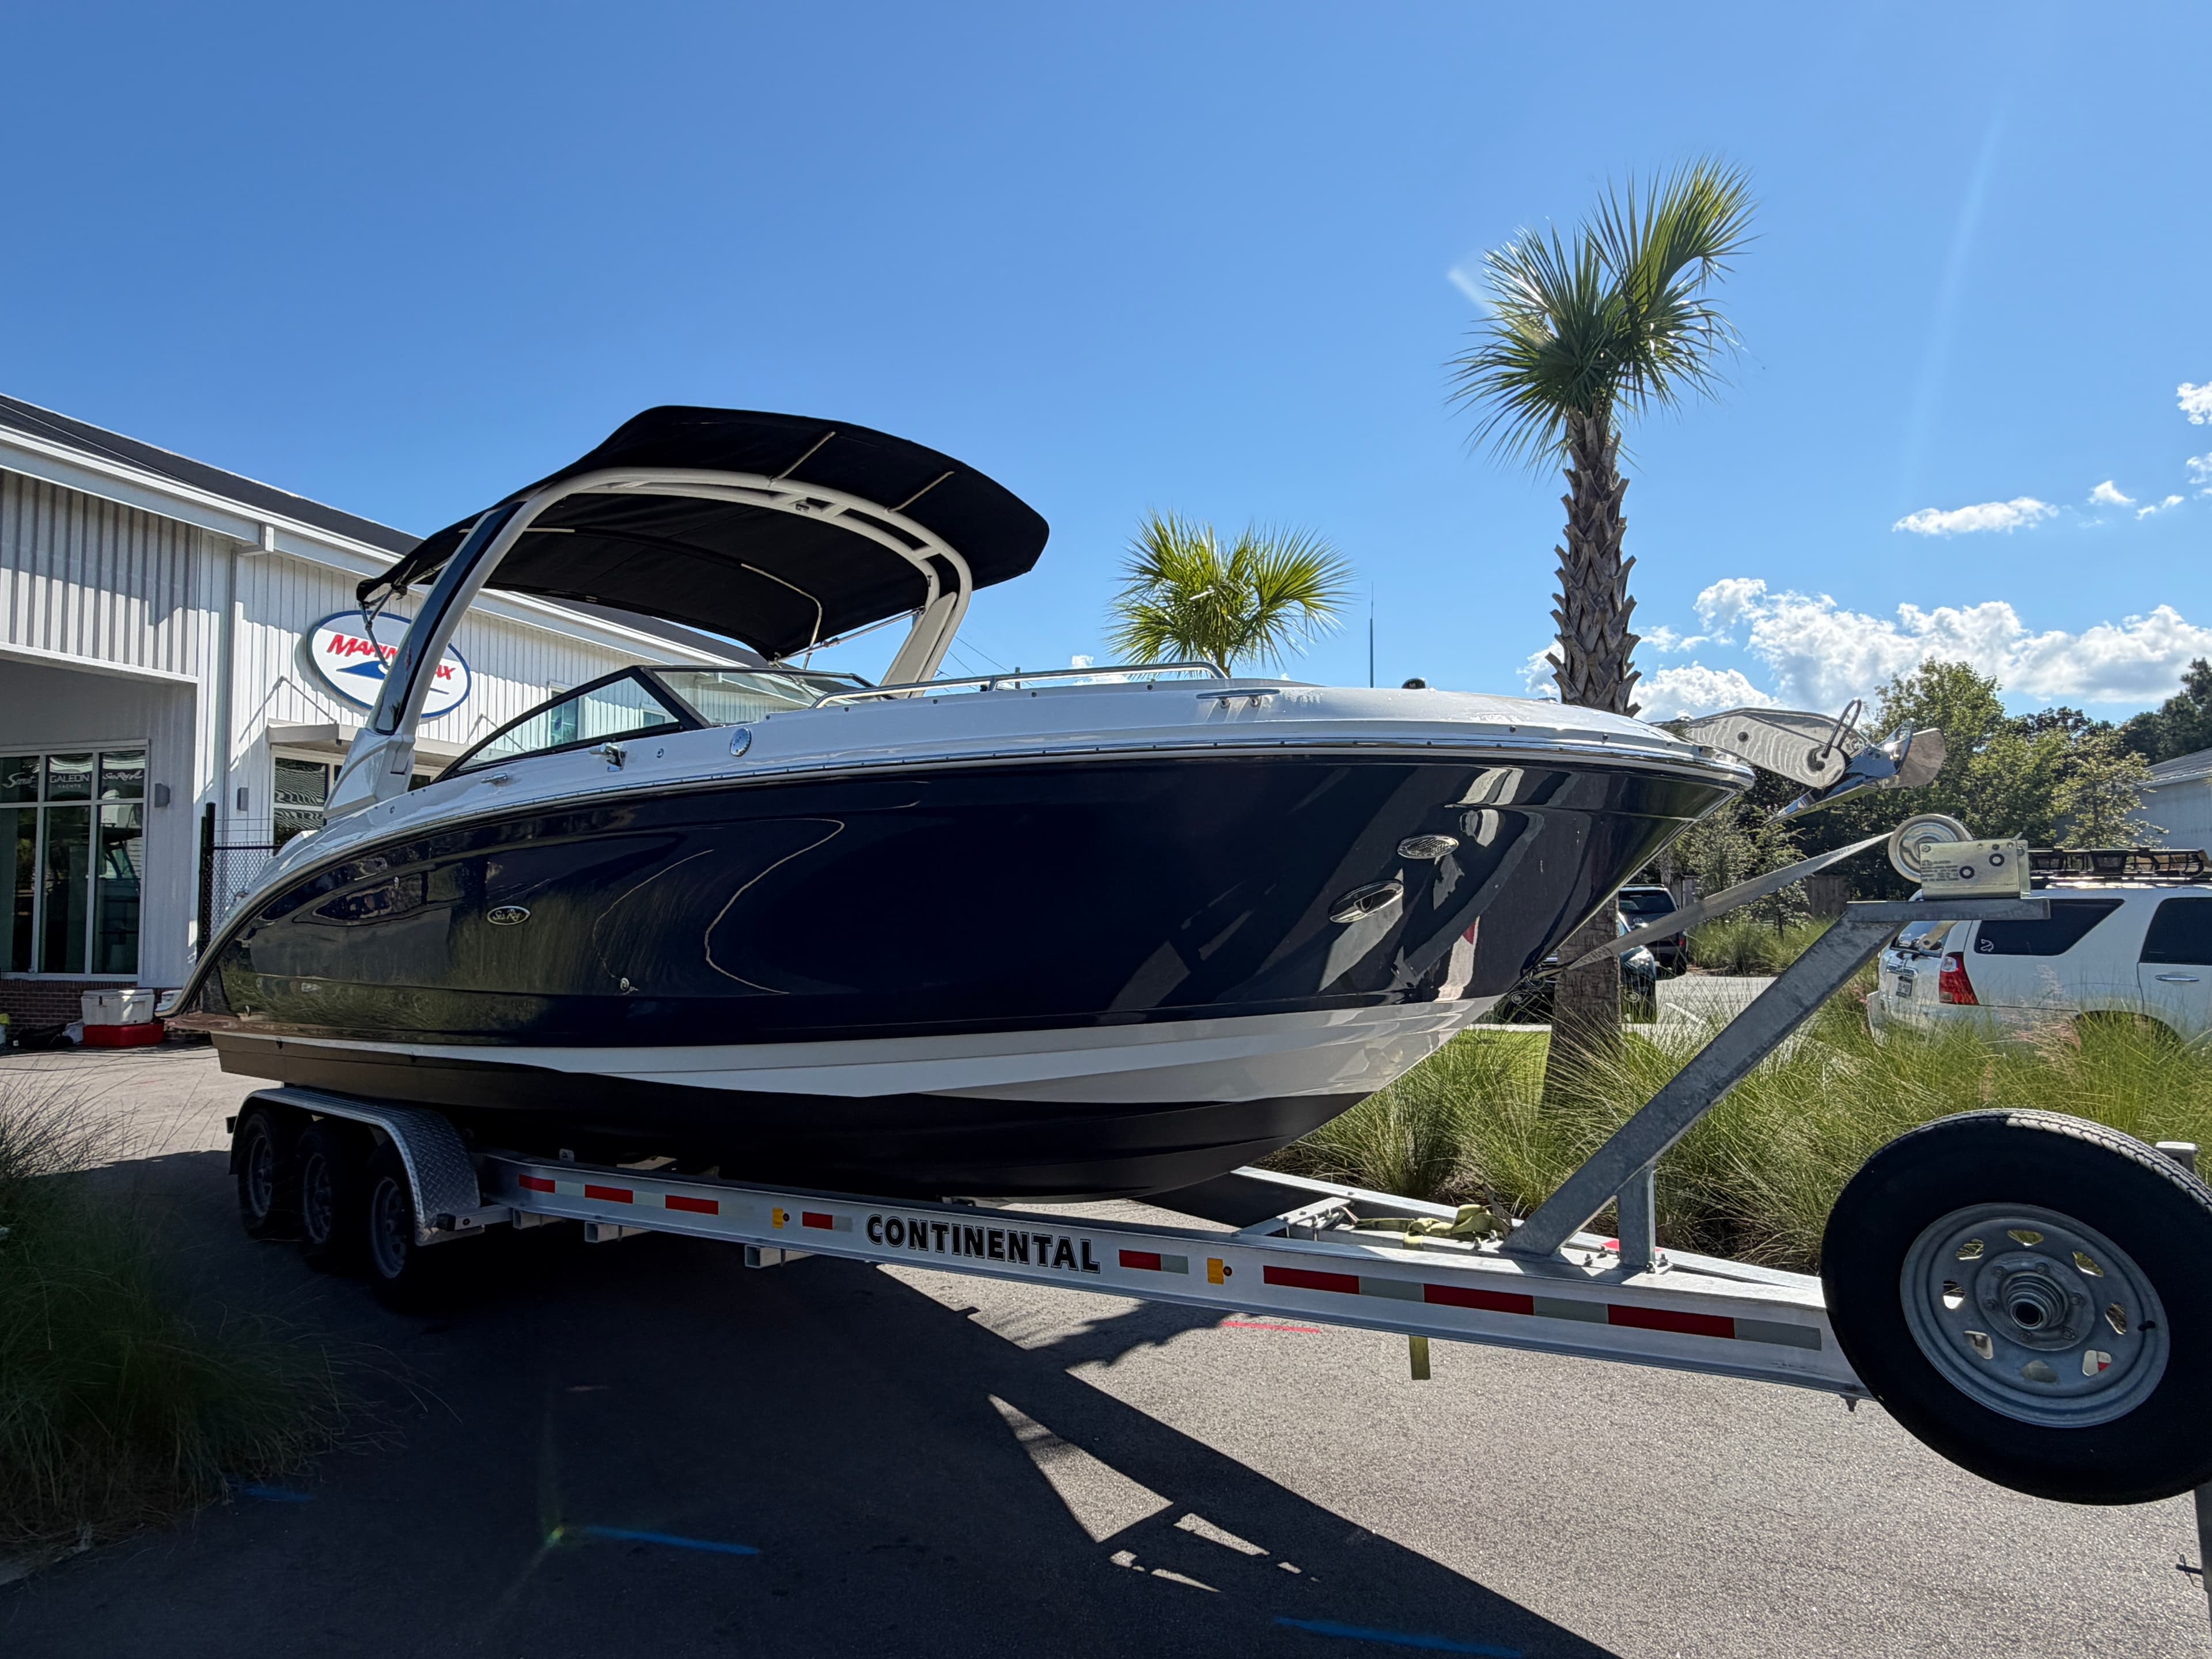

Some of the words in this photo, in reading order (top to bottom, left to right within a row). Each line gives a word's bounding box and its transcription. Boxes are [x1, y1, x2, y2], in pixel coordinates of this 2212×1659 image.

[327, 634, 456, 680] MARINAX
[50, 774, 90, 783] GALEON
[866, 1214, 1101, 1274] CONTINENTAL
